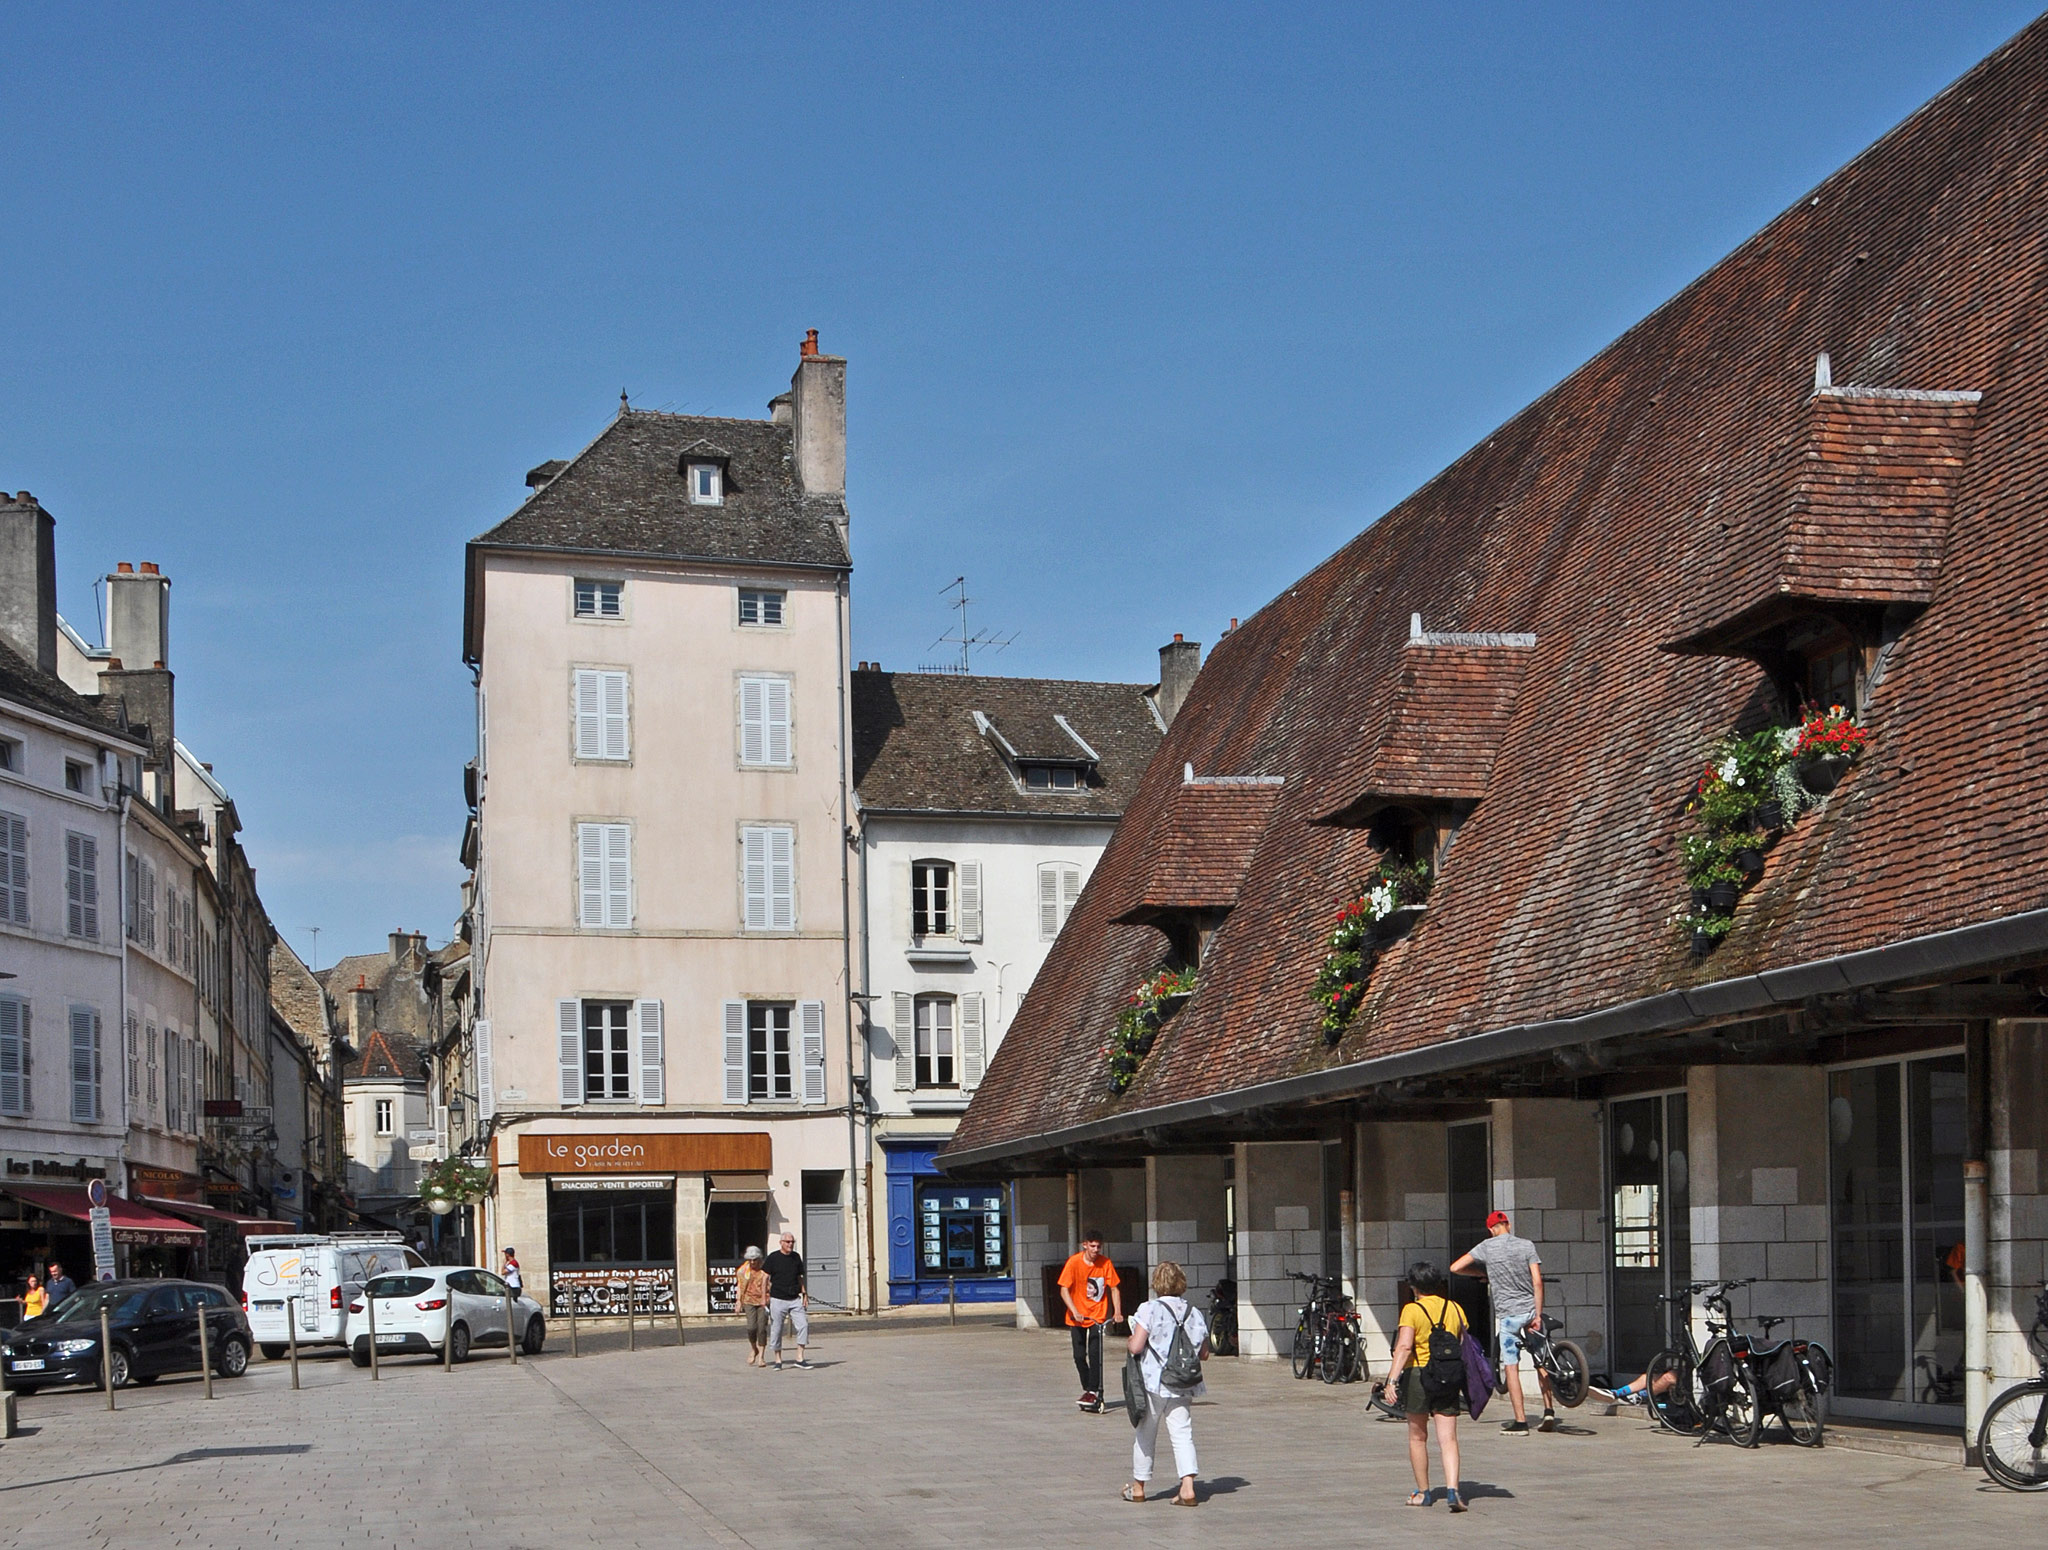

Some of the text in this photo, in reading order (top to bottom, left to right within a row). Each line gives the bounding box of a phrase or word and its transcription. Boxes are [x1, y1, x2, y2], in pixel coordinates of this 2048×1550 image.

[574, 1137, 645, 1168] garden
[142, 1170, 180, 1181] NICOLAS
[207, 1184, 240, 1192] NICOLAS
[561, 1180, 664, 1190] SNACKING VENTE EMPORTER
[114, 1231, 133, 1243] Coffee
[134, 1232, 148, 1244] Shop
[585, 1270, 609, 1278] made
[638, 1269, 657, 1277] food
[710, 1267, 736, 1276] TAKE
